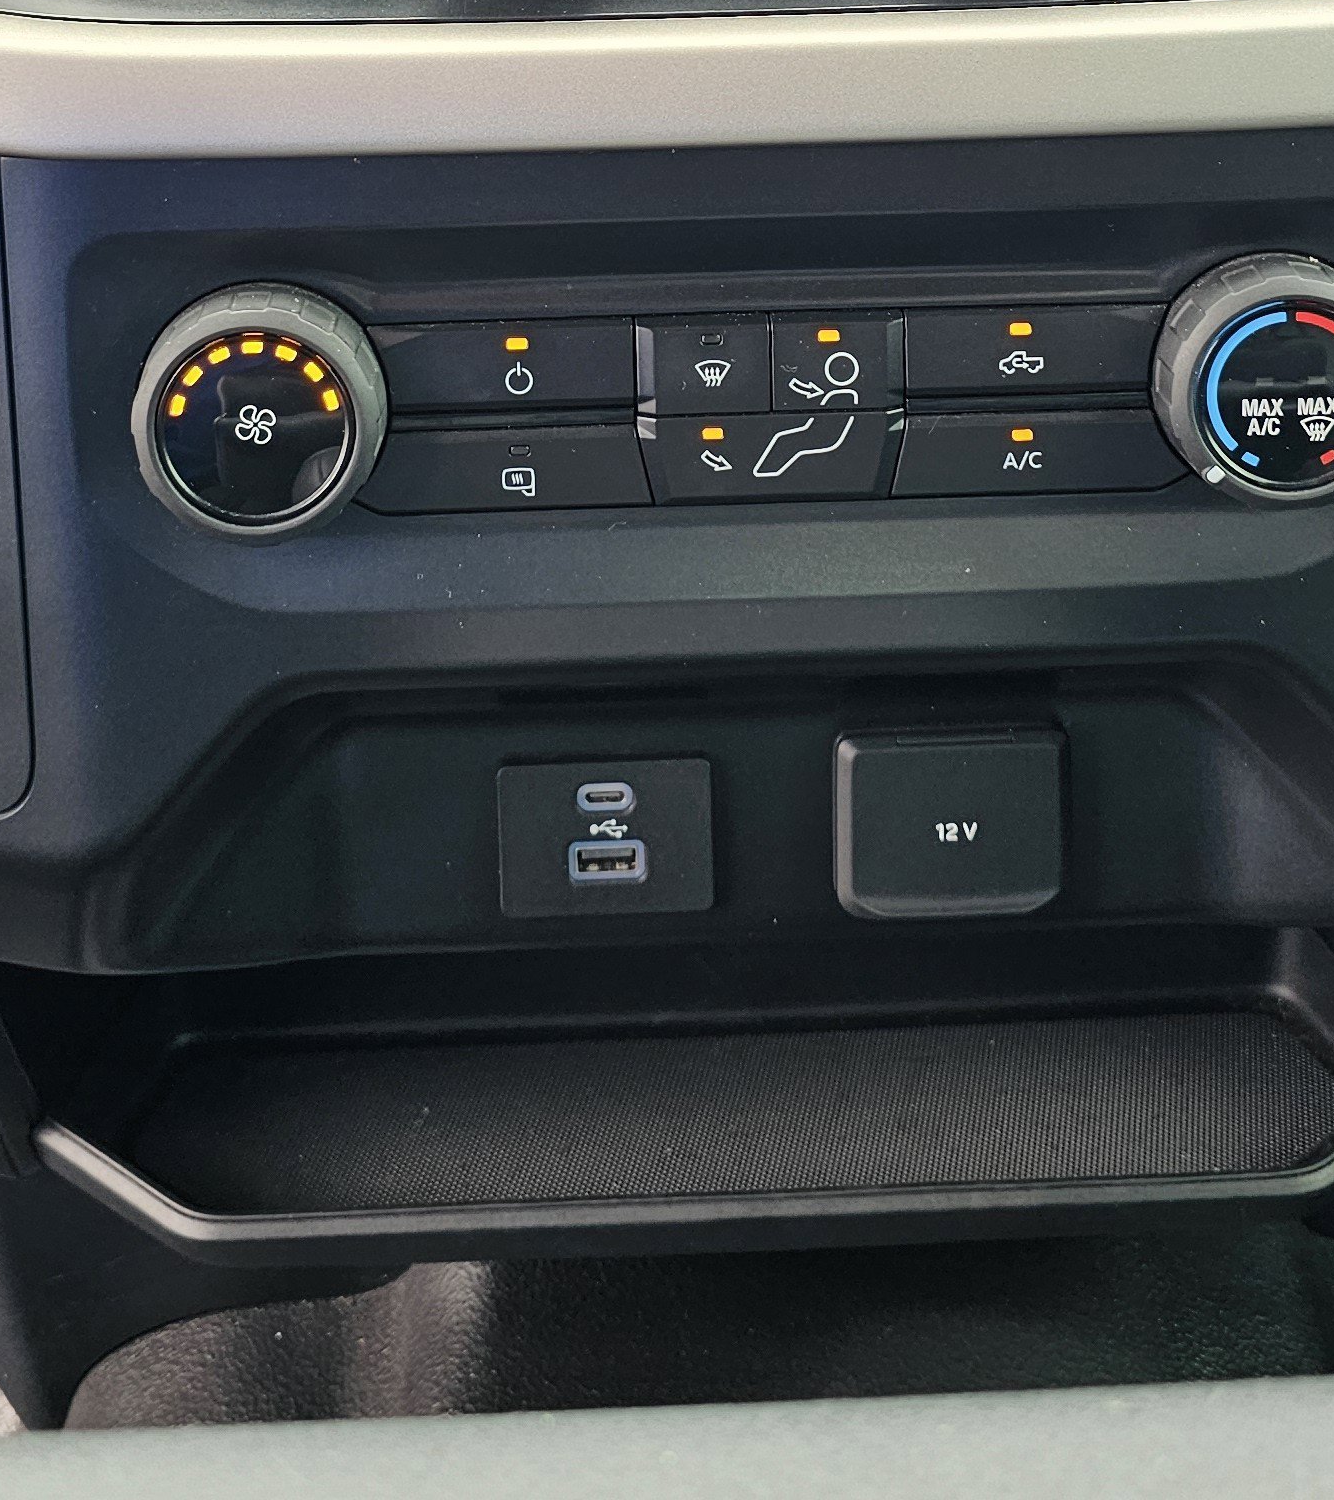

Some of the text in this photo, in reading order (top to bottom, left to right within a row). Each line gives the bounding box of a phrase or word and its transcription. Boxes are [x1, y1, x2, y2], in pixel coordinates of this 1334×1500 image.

[1241, 397, 1284, 417] MAX
[1247, 417, 1282, 438] A/C
[1002, 450, 1043, 470] A/C
[935, 822, 978, 842] 12 V
